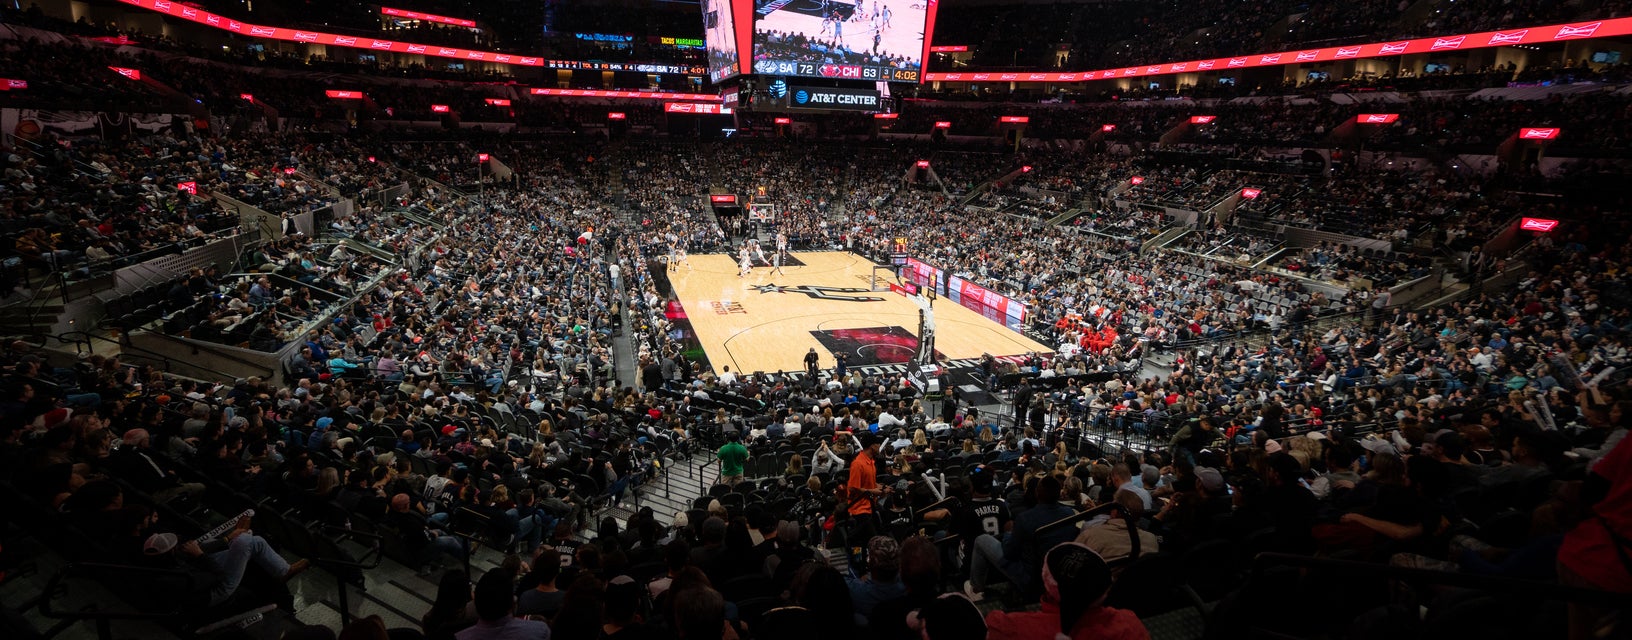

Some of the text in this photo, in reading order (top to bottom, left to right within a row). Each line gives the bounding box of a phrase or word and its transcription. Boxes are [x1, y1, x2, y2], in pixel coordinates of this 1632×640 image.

[661, 36, 703, 46] TACOS MARGARITAS
[656, 65, 667, 73] SA
[669, 66, 679, 74] 72
[779, 64, 793, 75] SA
[800, 64, 813, 76] 72
[843, 66, 859, 77] CHI
[864, 68, 876, 78] 63
[895, 70, 917, 81] 4:02
[810, 93, 877, 105] AT&T CENTER
[974, 505, 1000, 518] PARKER
[982, 516, 1000, 537] 9
